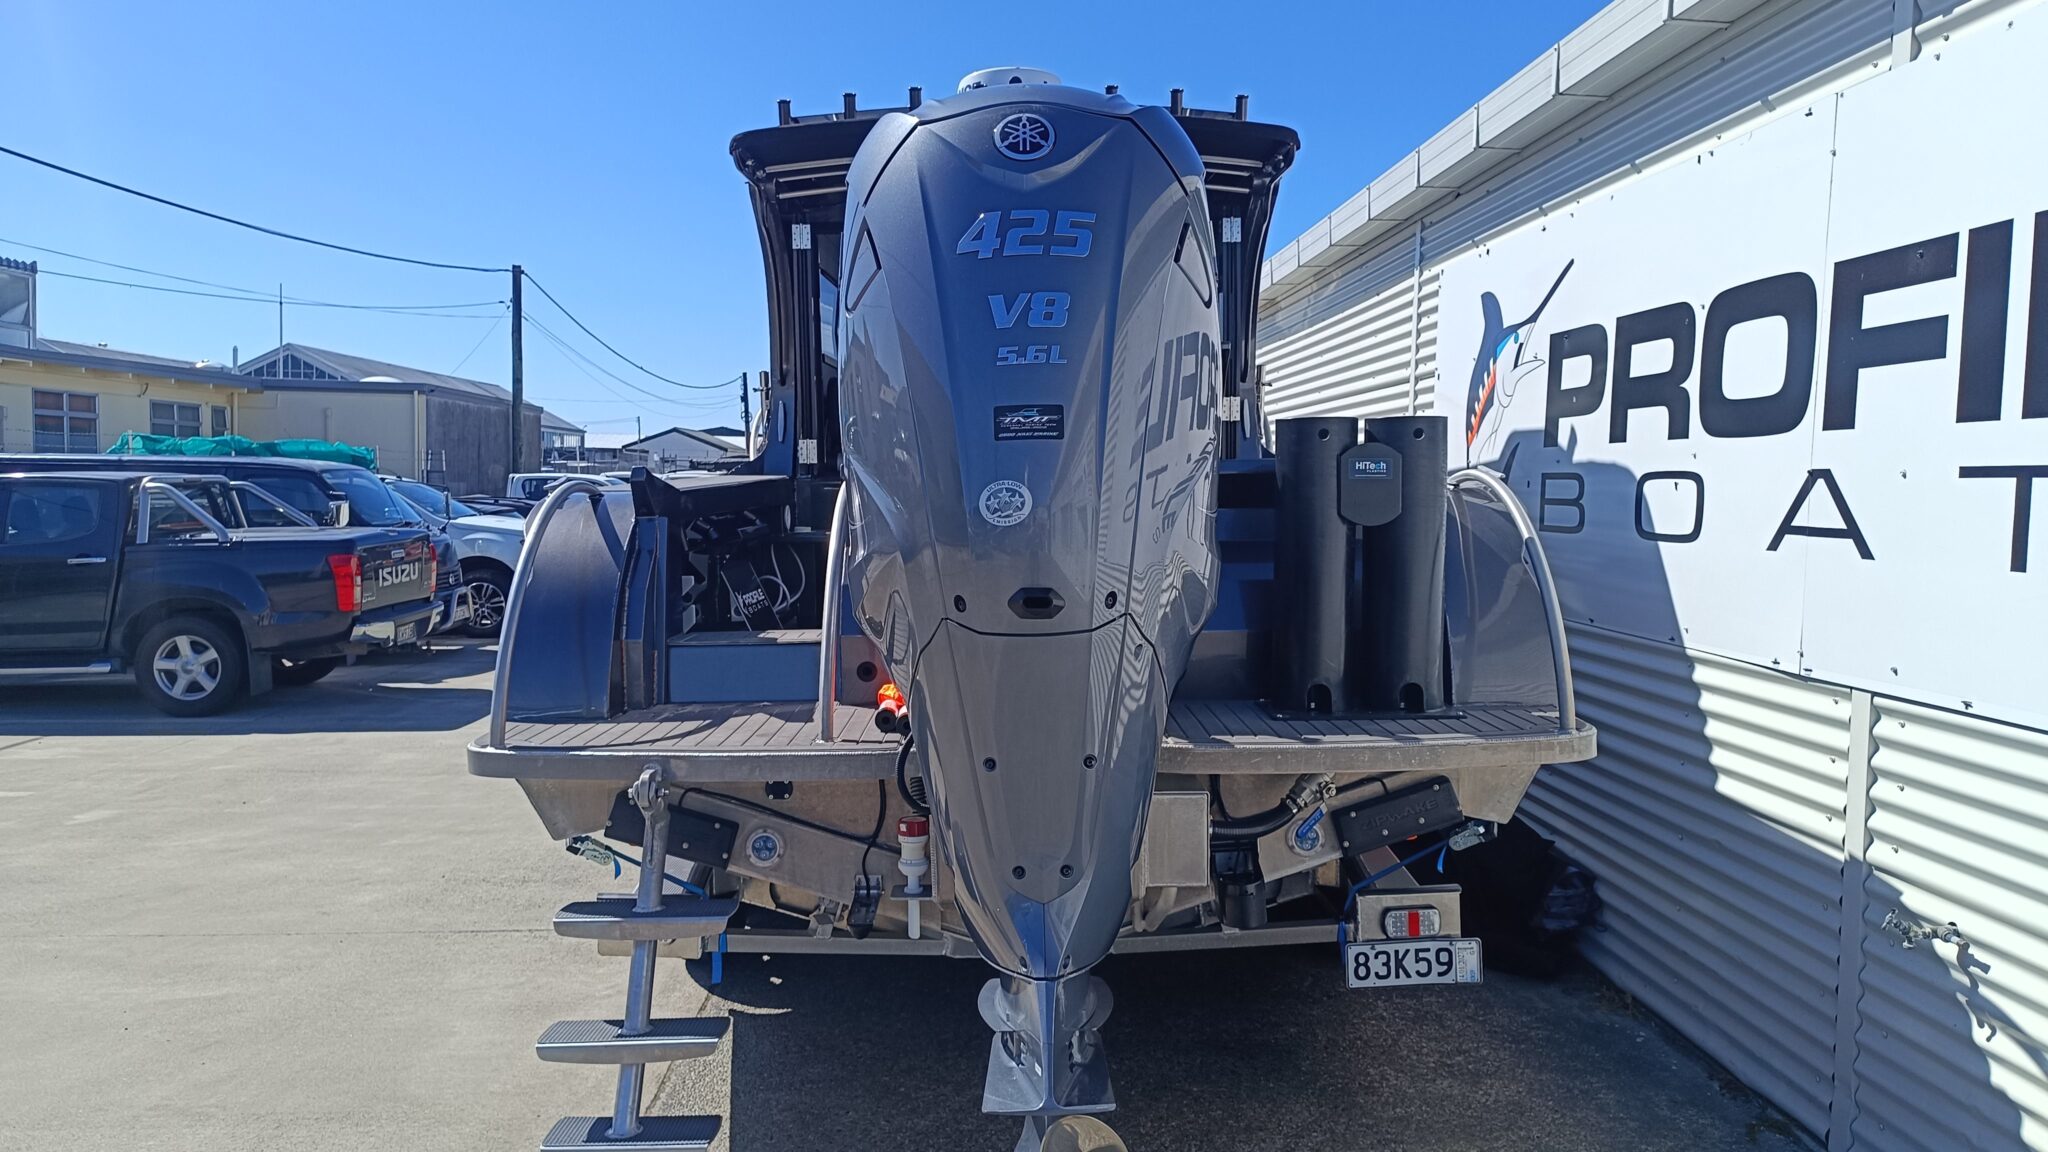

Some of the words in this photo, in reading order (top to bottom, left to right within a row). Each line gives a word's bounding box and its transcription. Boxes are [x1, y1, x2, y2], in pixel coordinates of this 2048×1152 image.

[956, 209, 1097, 259] 425
[988, 291, 1071, 329] V8
[996, 345, 1067, 366] 5.6L
[986, 481, 1006, 493] ULTRA
[1007, 481, 1023, 490] LOW
[992, 515, 1022, 525] EMISSION
[378, 562, 419, 588] ISUZU
[743, 588, 766, 606] PROFILE
[749, 600, 769, 613] BOATS
[1353, 947, 1454, 981] 83K59
